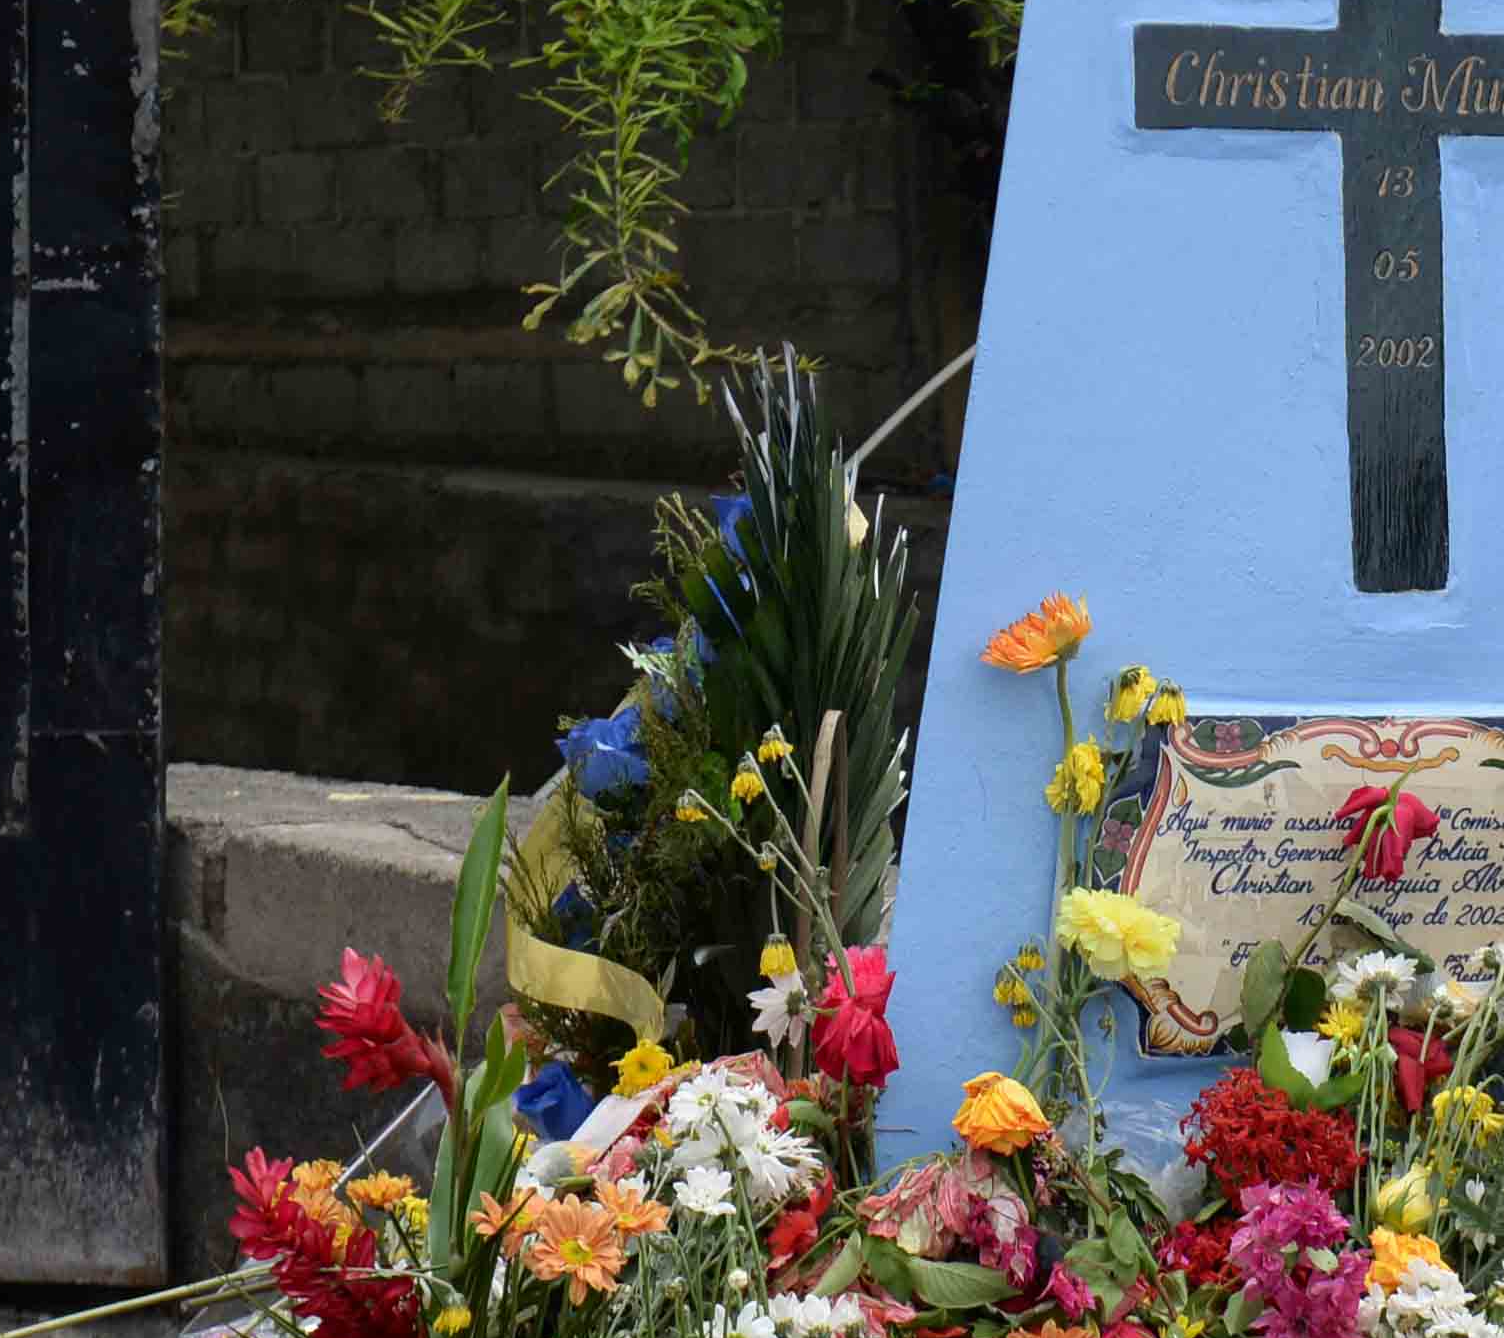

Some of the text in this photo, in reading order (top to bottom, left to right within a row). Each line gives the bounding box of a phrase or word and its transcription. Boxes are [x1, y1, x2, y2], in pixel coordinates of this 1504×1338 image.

[1164, 50, 1385, 113] Christian
[1376, 165, 1415, 198] 13
[1372, 246, 1421, 281] 05
[1355, 334, 1435, 368] 2002
[1284, 810, 1359, 831] asesina
[1183, 838, 1267, 870] Inspector
[1268, 838, 1348, 868] General
[1210, 860, 1315, 895] Christian
[1422, 895, 1449, 926] de
